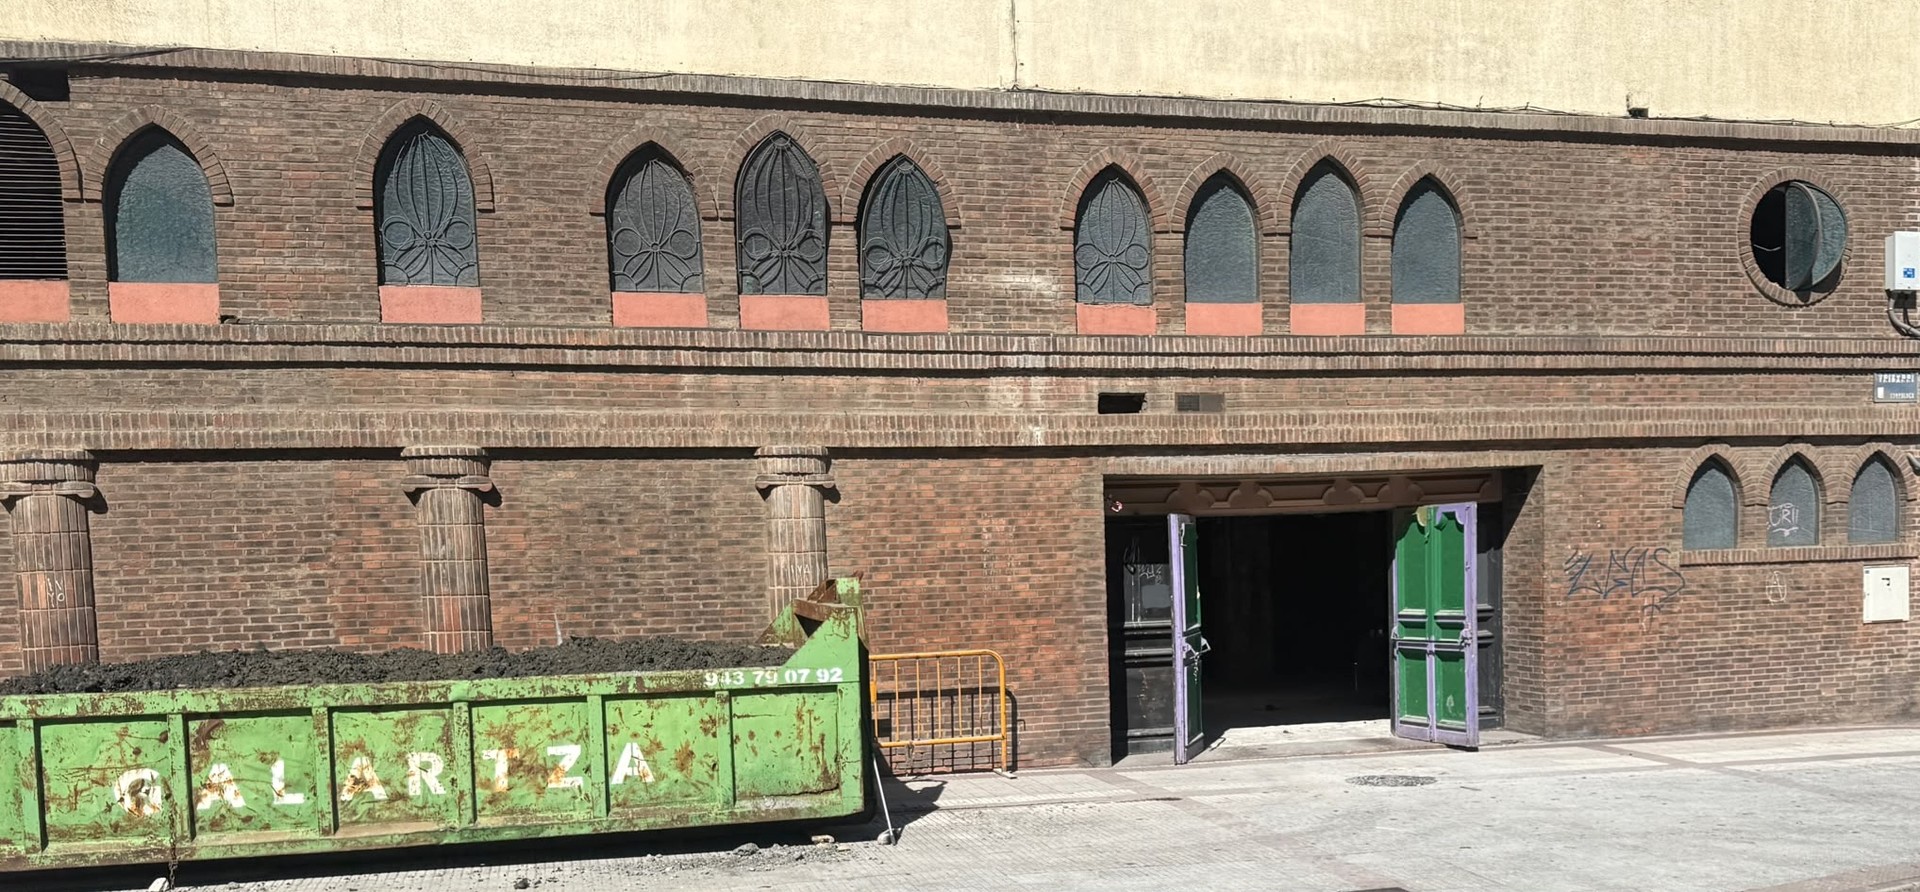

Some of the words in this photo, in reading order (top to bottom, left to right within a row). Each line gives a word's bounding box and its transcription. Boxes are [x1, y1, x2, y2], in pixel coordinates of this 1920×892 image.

[704, 670, 745, 686] 943
[752, 669, 778, 685] 79
[784, 668, 811, 684] 07
[816, 667, 844, 683] 92
[113, 741, 656, 818] GALARTZA
